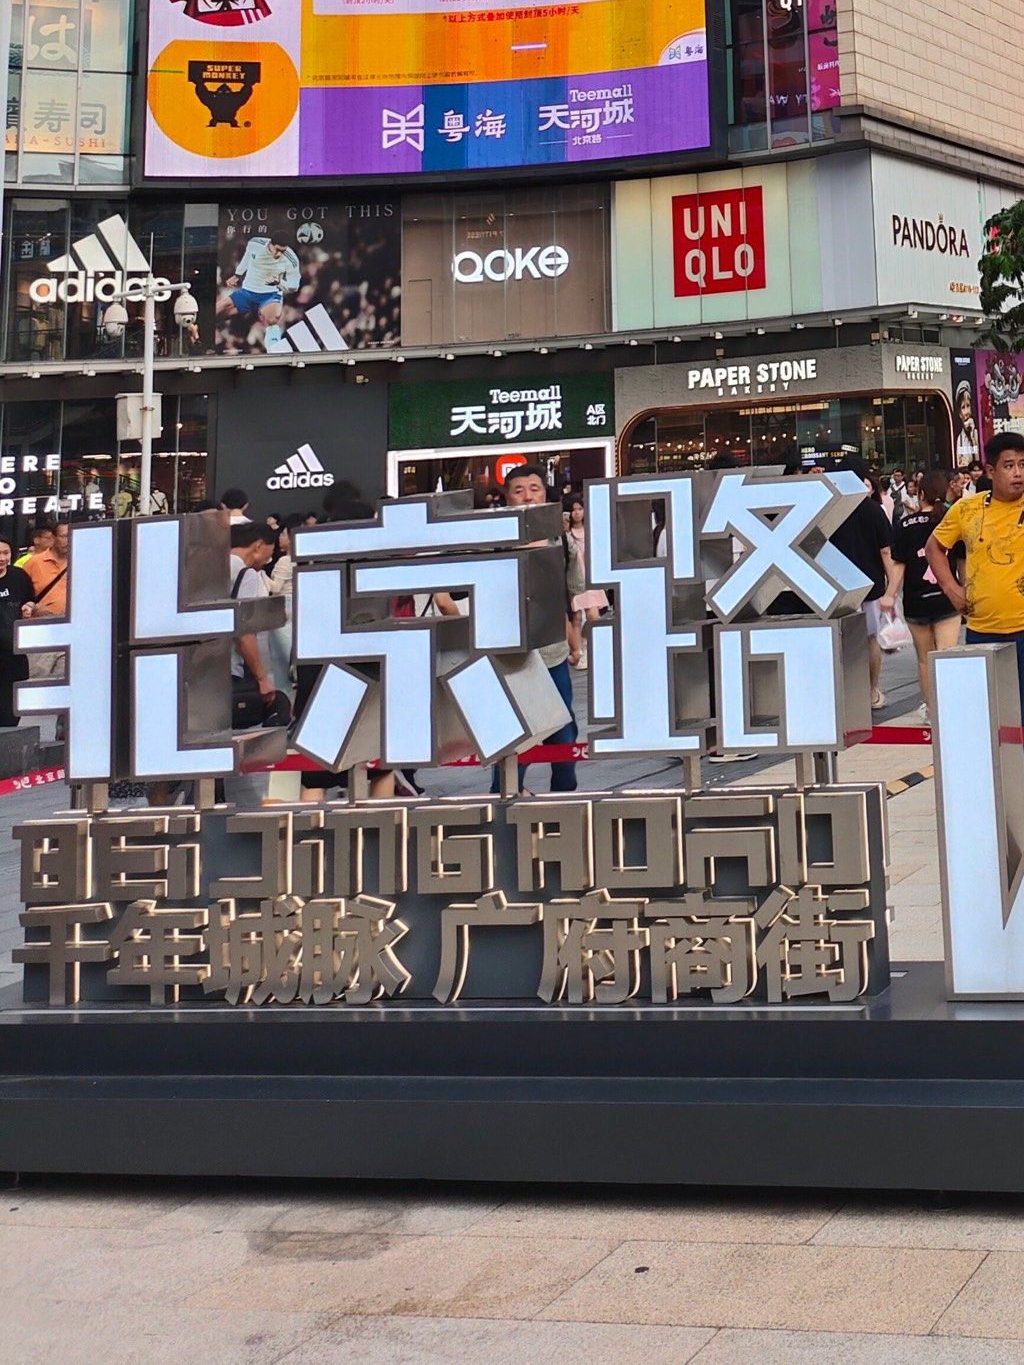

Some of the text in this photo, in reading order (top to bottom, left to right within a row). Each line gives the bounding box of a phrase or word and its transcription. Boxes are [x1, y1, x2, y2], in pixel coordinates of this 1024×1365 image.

[206, 64, 242, 72] SUPER
[569, 84, 633, 103] Teemall
[437, 109, 507, 143] 粤海
[538, 98, 635, 134] 天河城
[572, 135, 602, 146] 北京路
[227, 204, 394, 222] YOU GOT THIS
[683, 201, 746, 241] UNI
[226, 225, 268, 235] 你行的
[891, 214, 970, 258] PANDORA
[684, 243, 755, 288] QLO
[29, 270, 172, 303] adidas
[688, 358, 817, 390] PAPER STONE
[895, 355, 943, 373] PAPER STONE
[489, 385, 562, 404] Teemall
[717, 382, 790, 397] BAKERY
[586, 404, 606, 415] A区
[450, 401, 563, 439] 天河城
[586, 415, 606, 426] 北门
[266, 471, 335, 491] adidas
[14, 471, 872, 782] 北京路
[12, 885, 876, 1006] 千年城脉 广府商街
